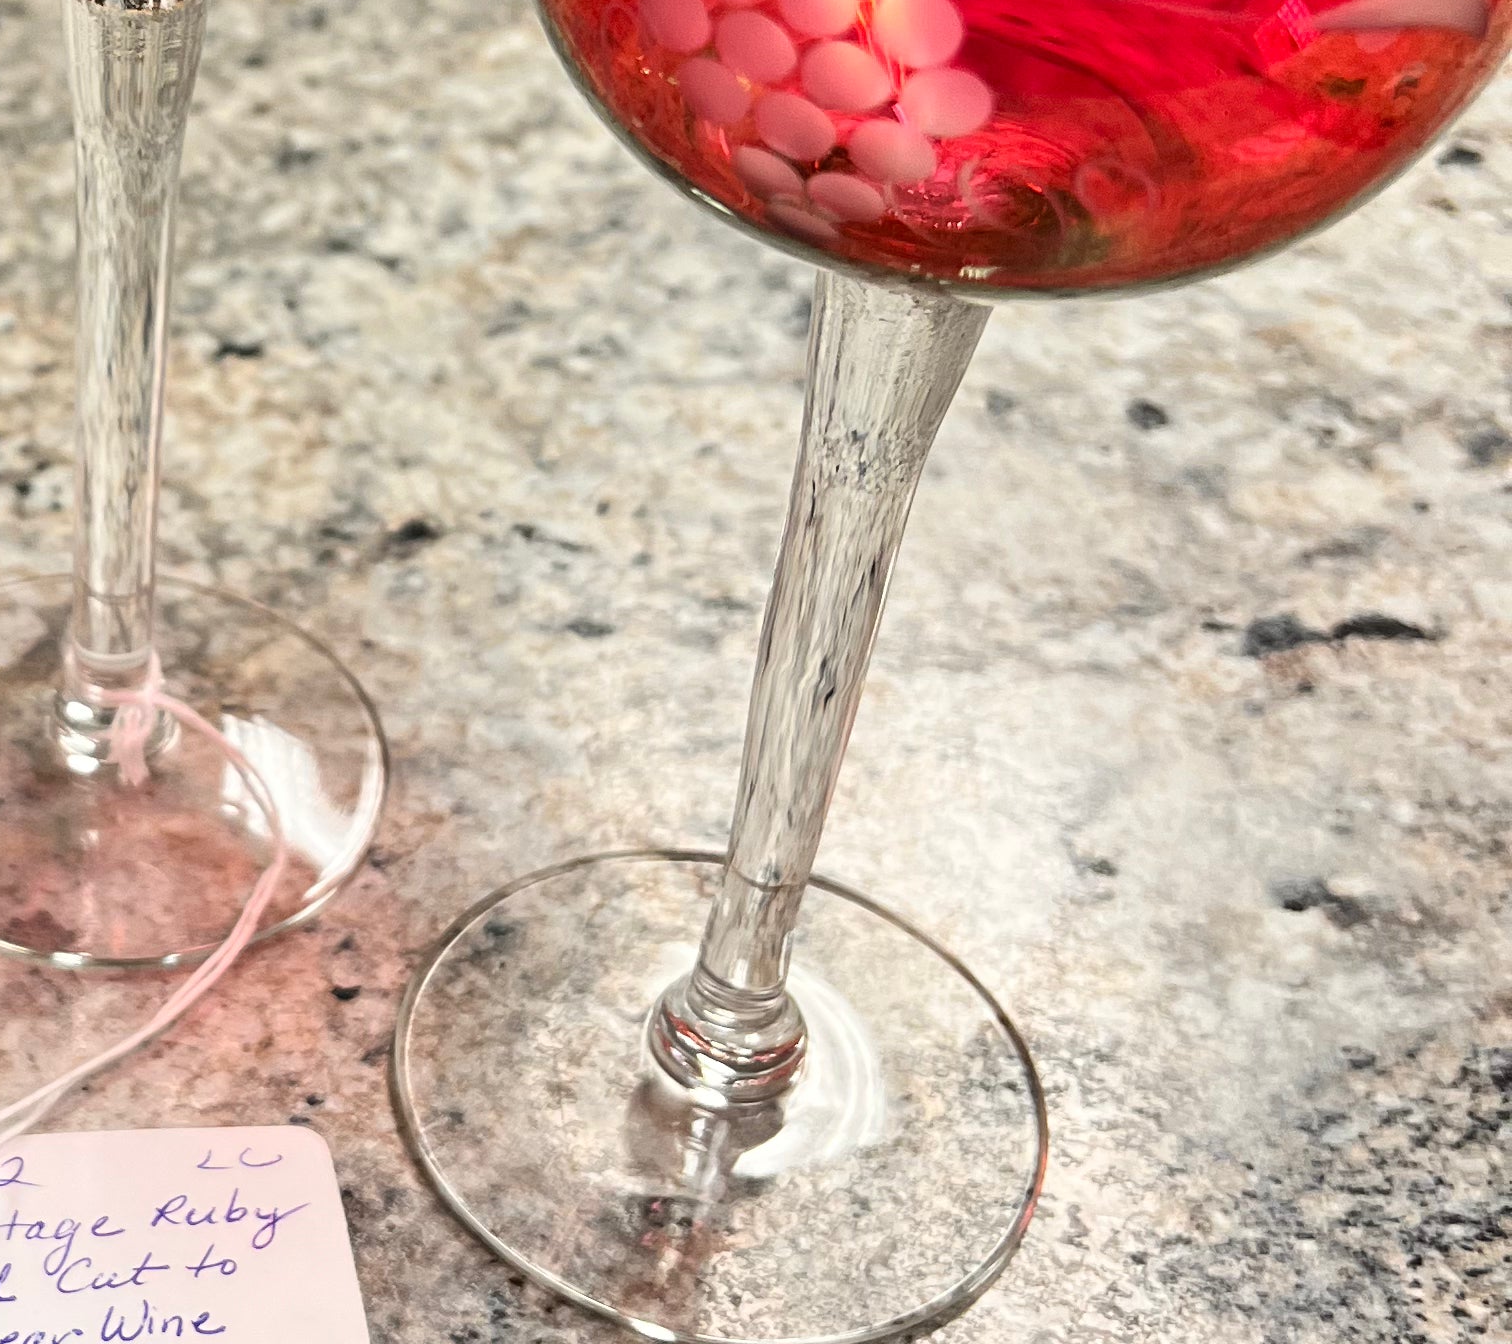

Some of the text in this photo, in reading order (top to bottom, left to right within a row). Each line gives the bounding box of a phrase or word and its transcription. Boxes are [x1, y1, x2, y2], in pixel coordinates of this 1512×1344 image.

[150, 1187, 312, 1250] Ruby
[57, 1252, 170, 1294] Cut
[185, 1243, 238, 1278] to
[100, 1299, 227, 1342] Wine
